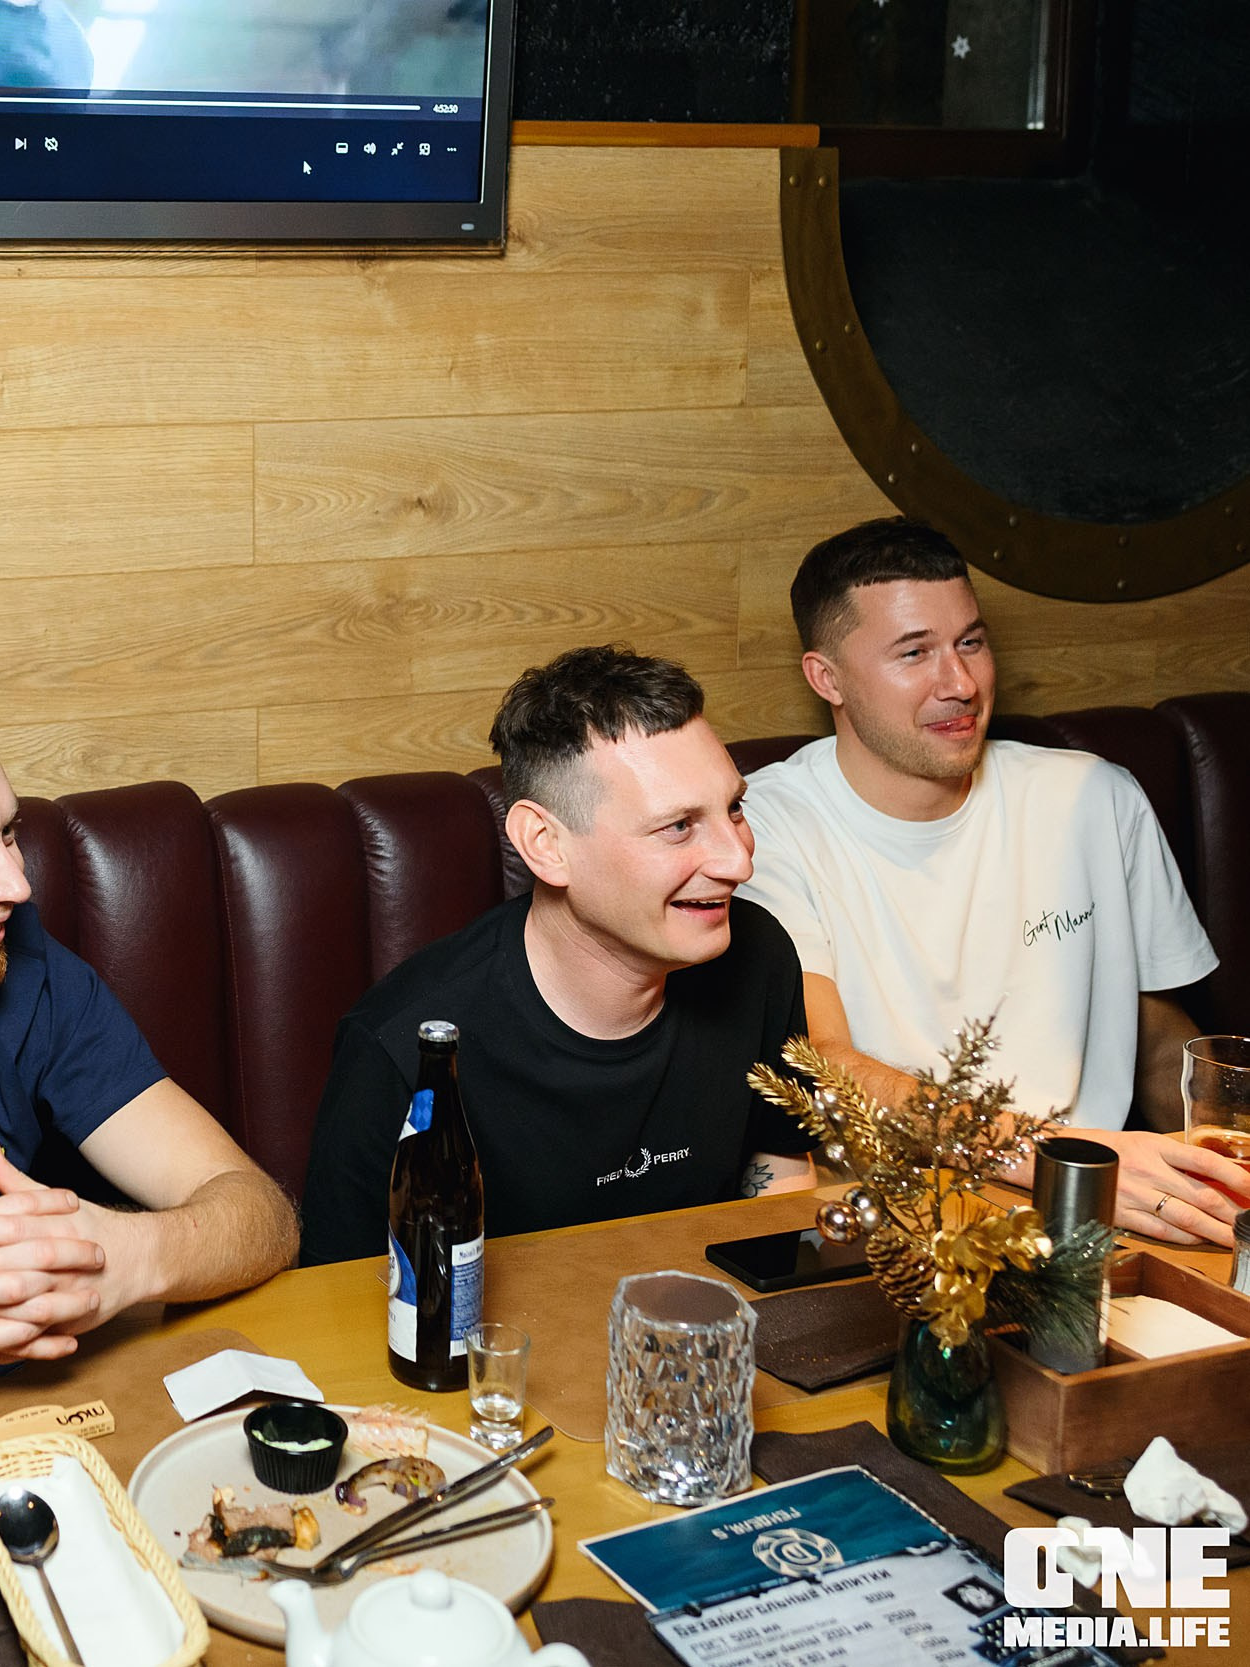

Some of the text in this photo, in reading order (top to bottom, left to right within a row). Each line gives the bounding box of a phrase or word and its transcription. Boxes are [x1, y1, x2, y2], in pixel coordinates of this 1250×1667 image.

[597, 1147, 690, 1187] FRED PERRY
[822, 1567, 892, 1595] напитки
